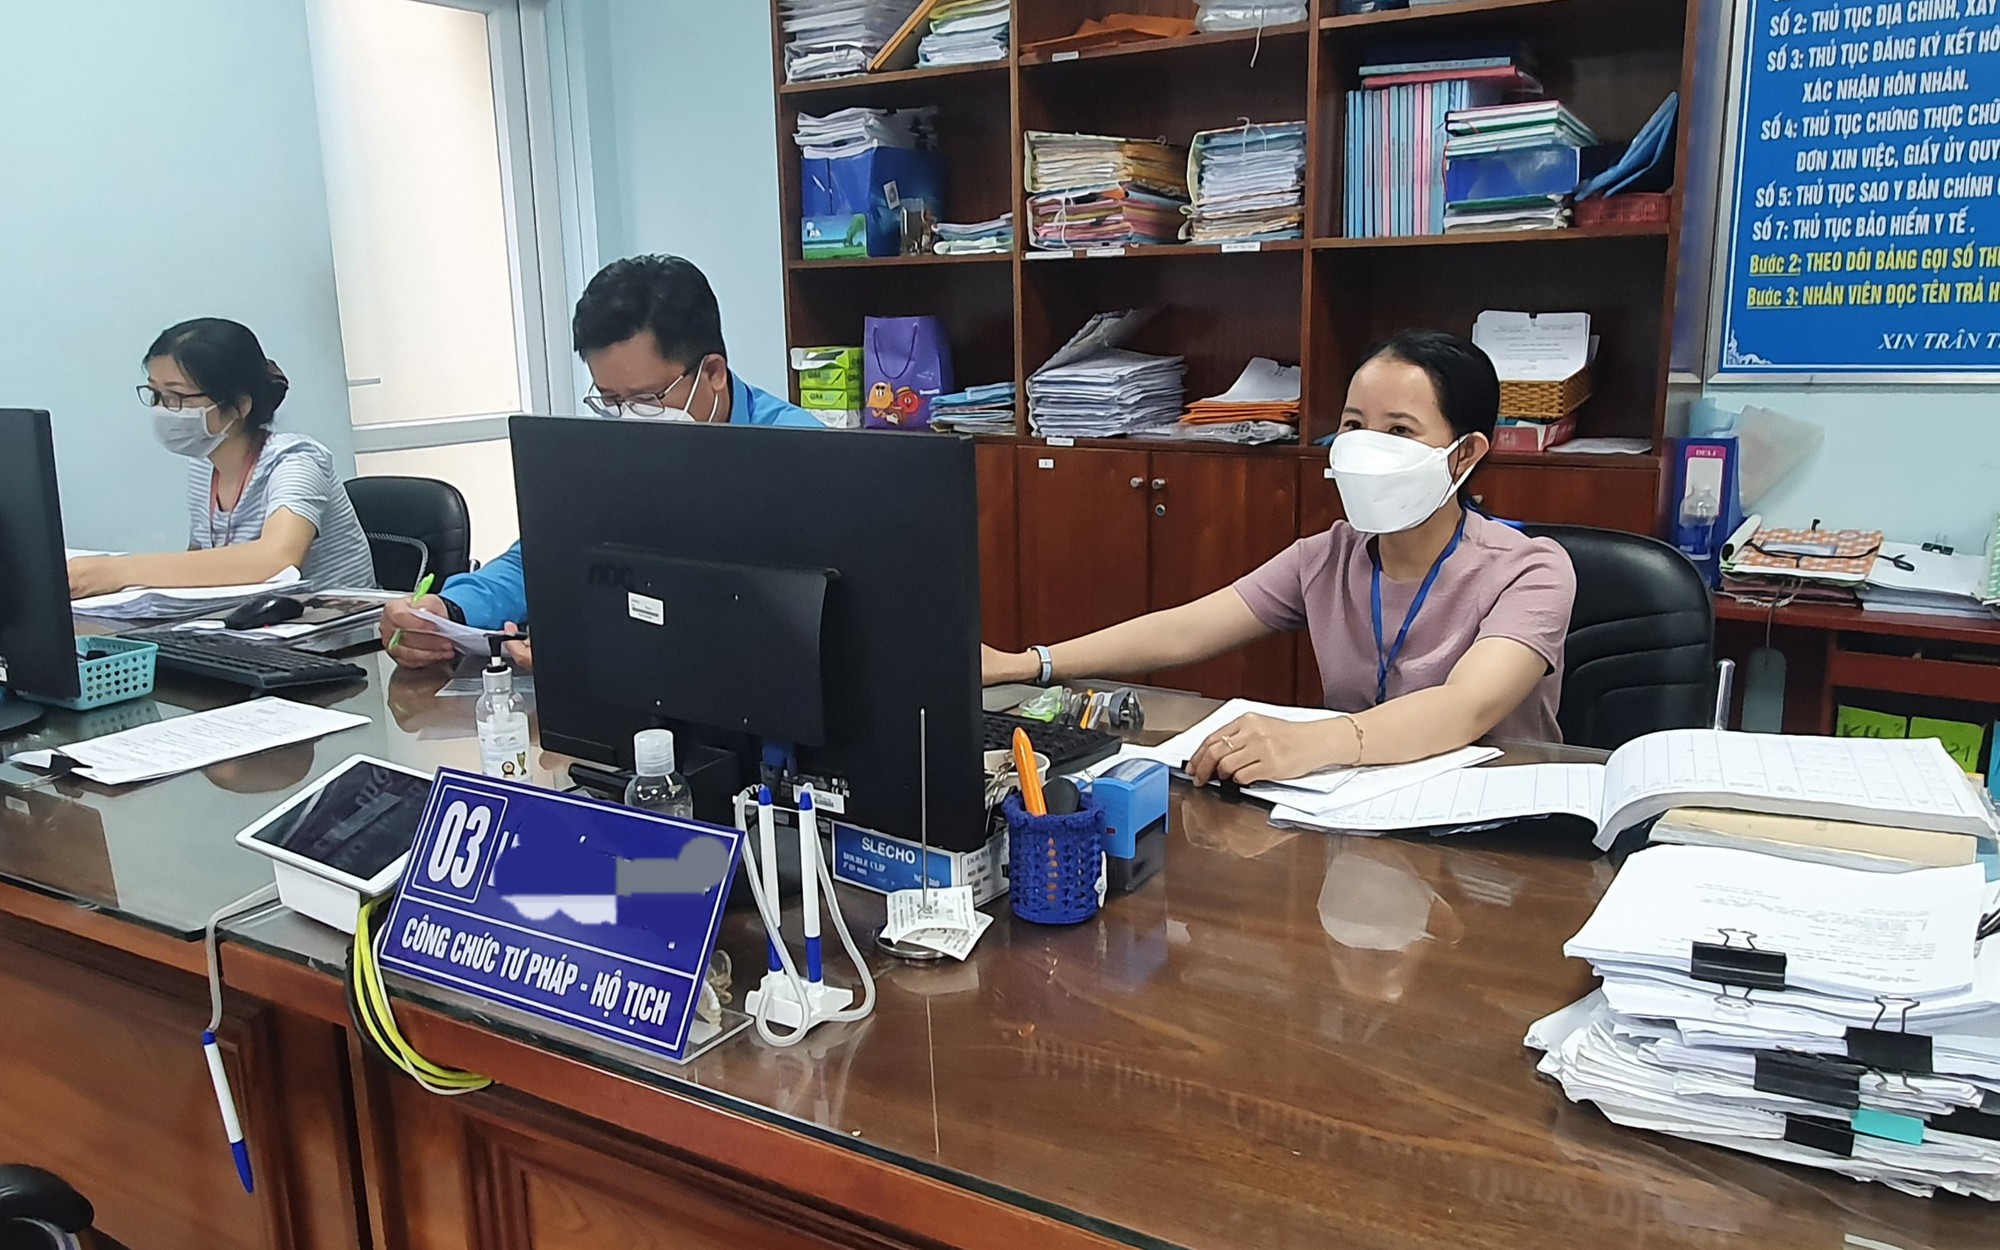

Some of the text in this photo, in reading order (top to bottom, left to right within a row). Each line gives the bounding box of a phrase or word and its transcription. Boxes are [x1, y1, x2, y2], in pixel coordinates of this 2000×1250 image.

[1769, 7, 1791, 37] SỐ
[1793, 13, 1807, 35] 2:
[1811, 2, 1840, 33] THỦ
[1844, 5, 1873, 34] TỤC
[1876, 2, 1902, 30] ĐỊA
[1767, 42, 1788, 72] SỐ
[1790, 48, 1804, 70] 3:
[1808, 37, 1837, 69] THỦ
[1840, 41, 1869, 70] TỤC
[1872, 35, 1916, 62] ĐĂNG
[1944, 25, 1976, 56] KẾT
[1802, 65, 1969, 104] XÁC NHẬN HÔN NHÂN.
[1760, 111, 1783, 140] SỐ
[1784, 118, 1798, 139] 4:
[1801, 108, 1830, 138] THỦ
[1834, 112, 1862, 140] TỤC
[1866, 106, 1919, 133] CHỨNG
[1923, 103, 1963, 133] THỰC
[1796, 148, 1828, 173] ĐƠN
[1830, 148, 1858, 171] XIN
[1862, 142, 1899, 173] VIỆC,
[1903, 135, 1941, 166] GIẤY
[1943, 135, 1966, 163] ỦY
[1755, 180, 1776, 208] SỐ
[1778, 186, 1792, 207] 5:
[1796, 177, 1824, 207] THỦ
[1827, 182, 1855, 209] TỤC
[1859, 181, 1889, 203] SAO
[1893, 180, 1904, 202] Y
[1905, 172, 1940, 201] BẢN
[1943, 171, 1994, 199] CHÍNH
[1752, 213, 1773, 241] SỐ
[1775, 220, 1789, 240] 7:
[1793, 212, 1821, 240] THỦ
[1824, 217, 1852, 243] TỤC
[1855, 209, 1886, 237] BẢO
[1890, 206, 1930, 237] HIỂM
[1935, 213, 1945, 234] Y
[1750, 253, 1785, 274] Bước
[1788, 253, 1802, 274] 2:
[1806, 251, 1842, 272] THEO
[1846, 246, 1872, 271] DÕI
[1875, 243, 1917, 270] BẢNG
[1921, 247, 1948, 274] GỌI
[1951, 240, 1975, 269] SỐ
[1747, 286, 1782, 306] Bước
[1785, 286, 1799, 306] 3:
[1802, 281, 1844, 306] NHÂN
[1848, 280, 1882, 305] VIÊN
[1885, 283, 1917, 308] ĐỌC
[1921, 278, 1951, 304] TÊN
[1955, 275, 1984, 303] TRẢ
[1877, 333, 1918, 350] XIN
[1923, 328, 1981, 350] TRÂN
[427, 800, 491, 888] 03
[861, 836, 916, 865] SLECHO
[401, 914, 452, 959] CÔNG
[450, 932, 500, 973] CHỨC
[500, 945, 531, 981] TƯ
[523, 953, 579, 996] PHÁP
[589, 969, 622, 1018] HỘ
[622, 980, 672, 1026] TỊCH
